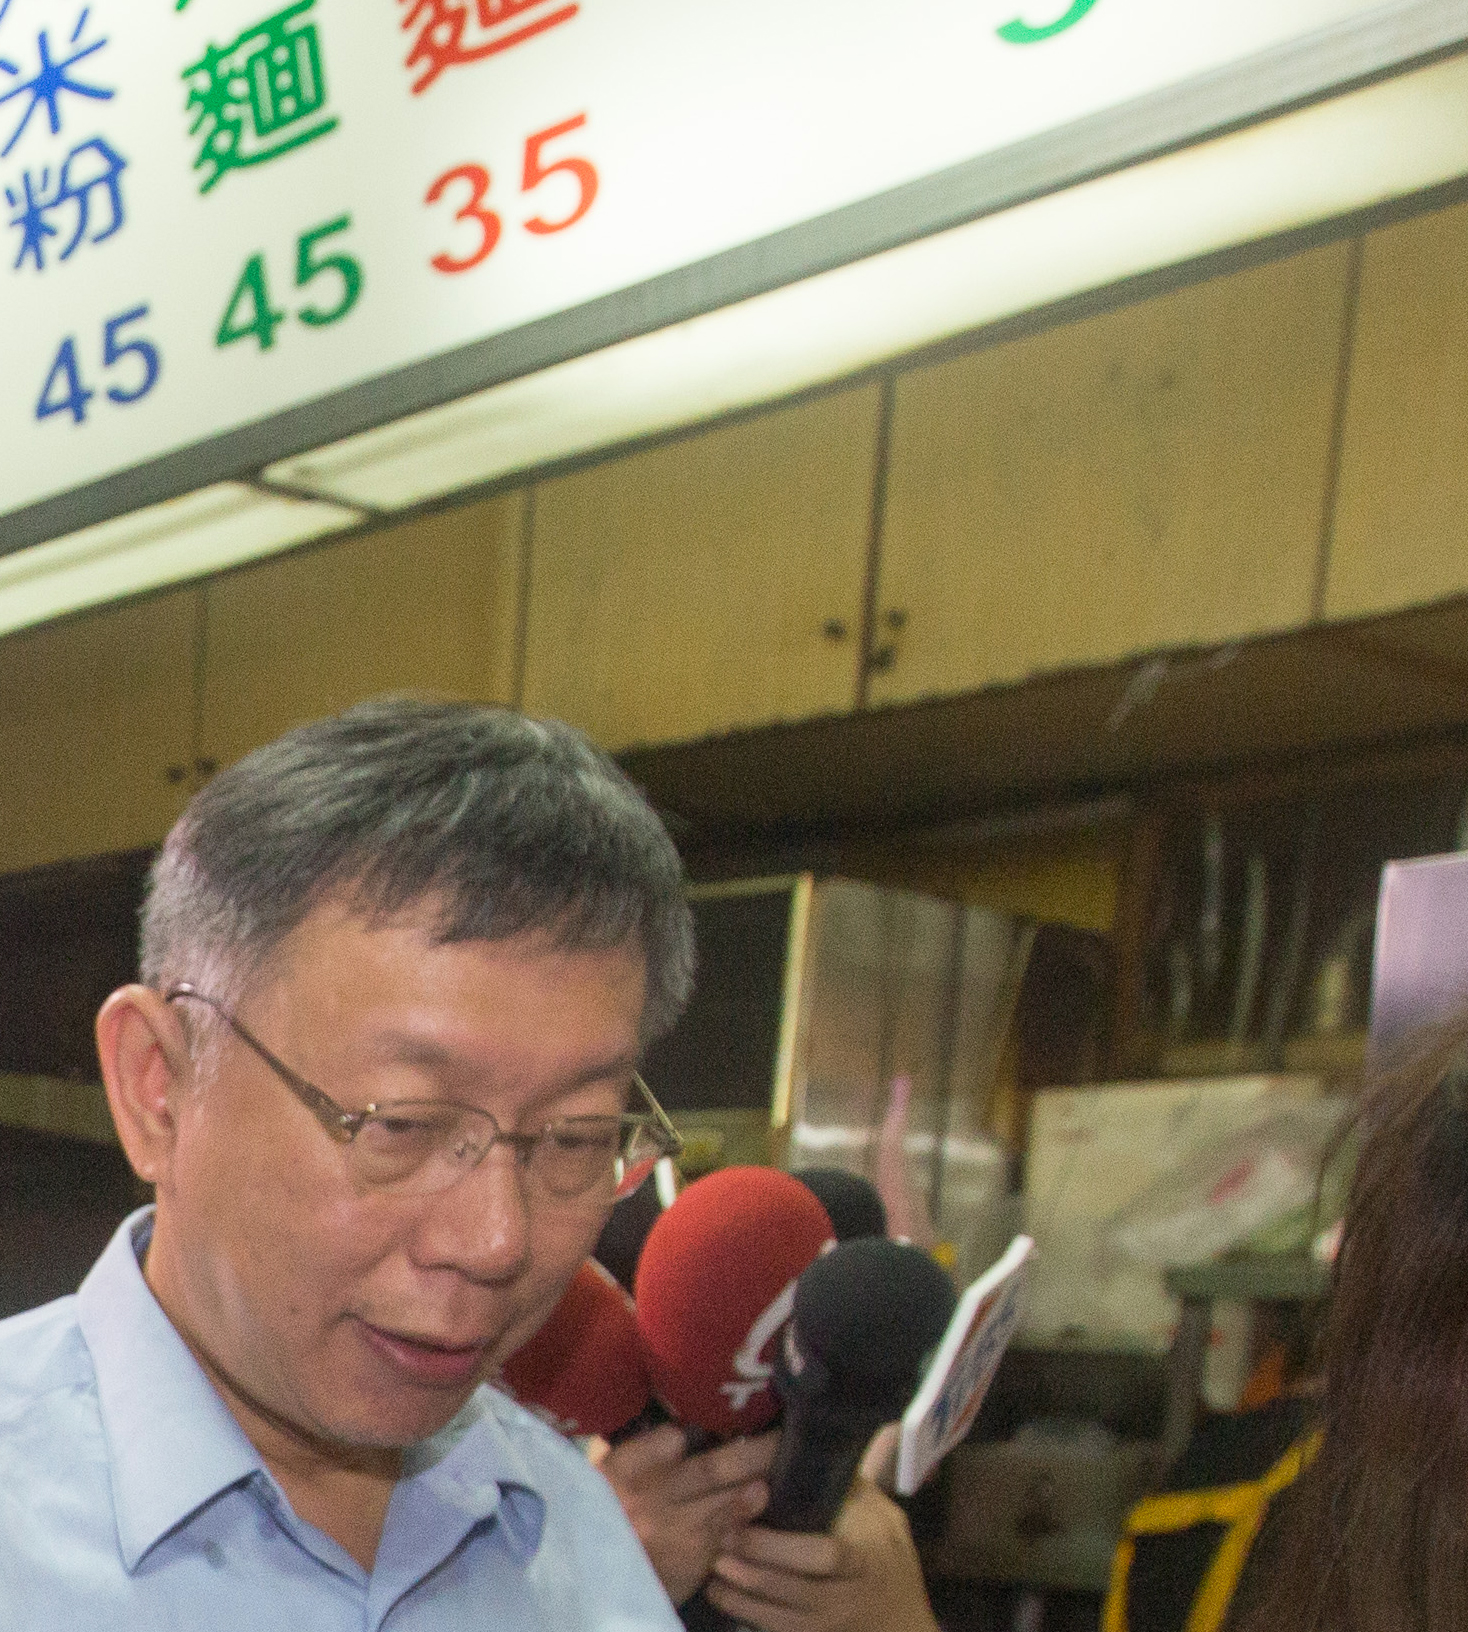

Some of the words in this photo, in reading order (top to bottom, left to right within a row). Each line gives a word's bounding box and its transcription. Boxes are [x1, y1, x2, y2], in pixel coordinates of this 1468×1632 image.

[423, 111, 602, 277] 35
[215, 215, 365, 350] 45
[33, 306, 163, 427] 45
